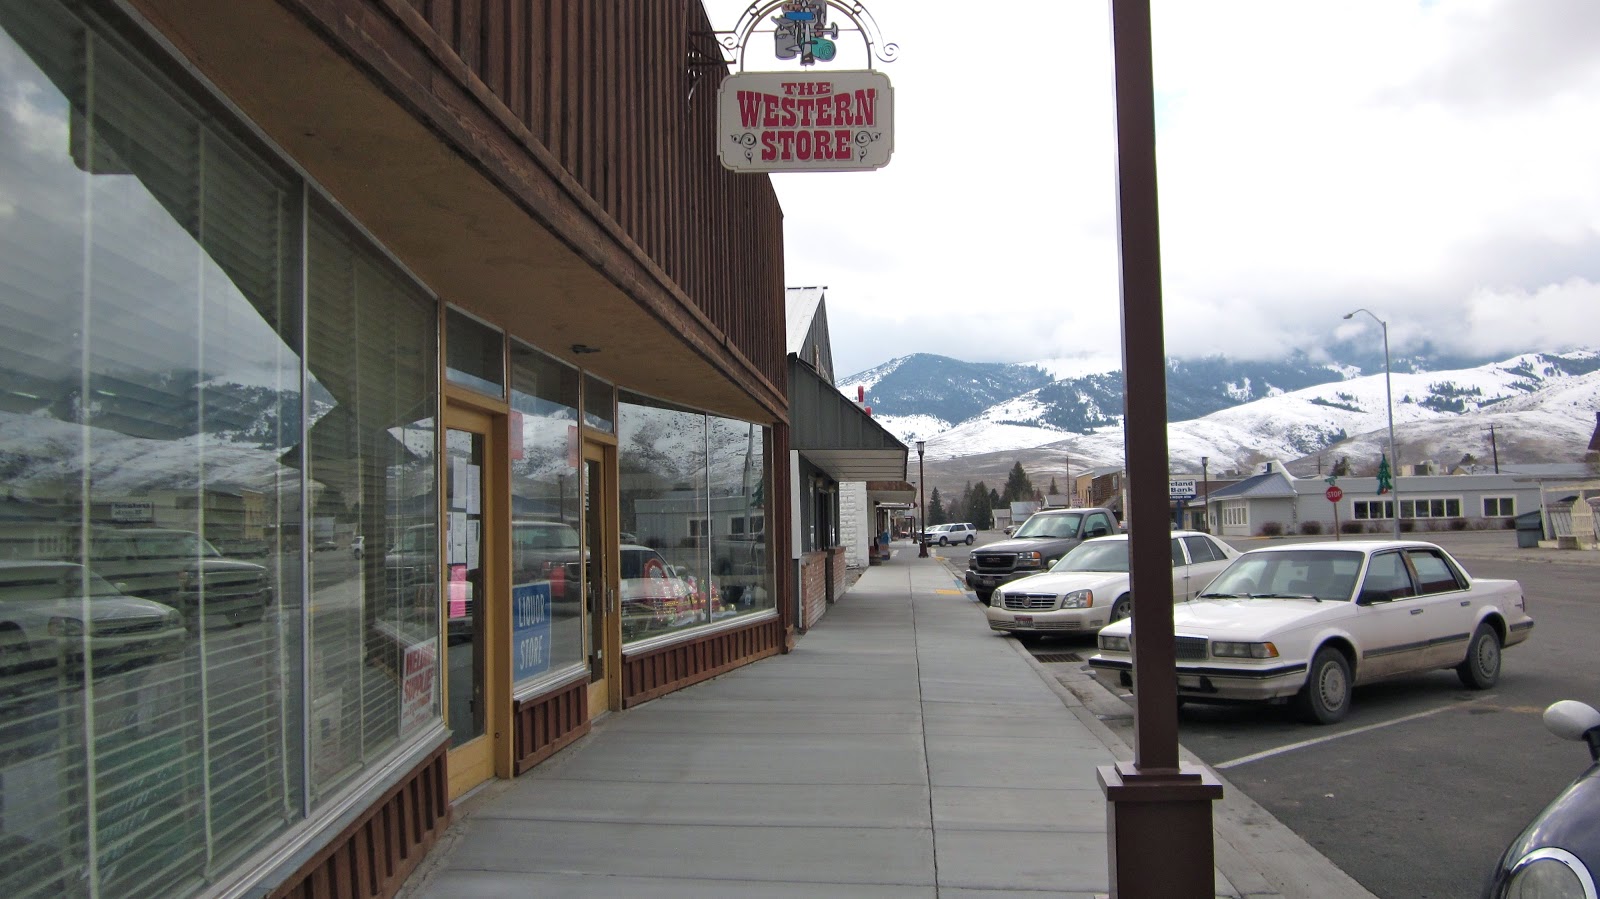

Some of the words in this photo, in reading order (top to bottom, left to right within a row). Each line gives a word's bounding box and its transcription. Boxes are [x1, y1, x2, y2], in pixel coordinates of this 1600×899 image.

[781, 82, 831, 95] THE
[736, 88, 876, 127] WESTERN
[761, 130, 851, 160] STORE
[1327, 490, 1342, 498] STOP
[518, 593, 545, 628] LIQUOR
[520, 635, 543, 670] STORE
